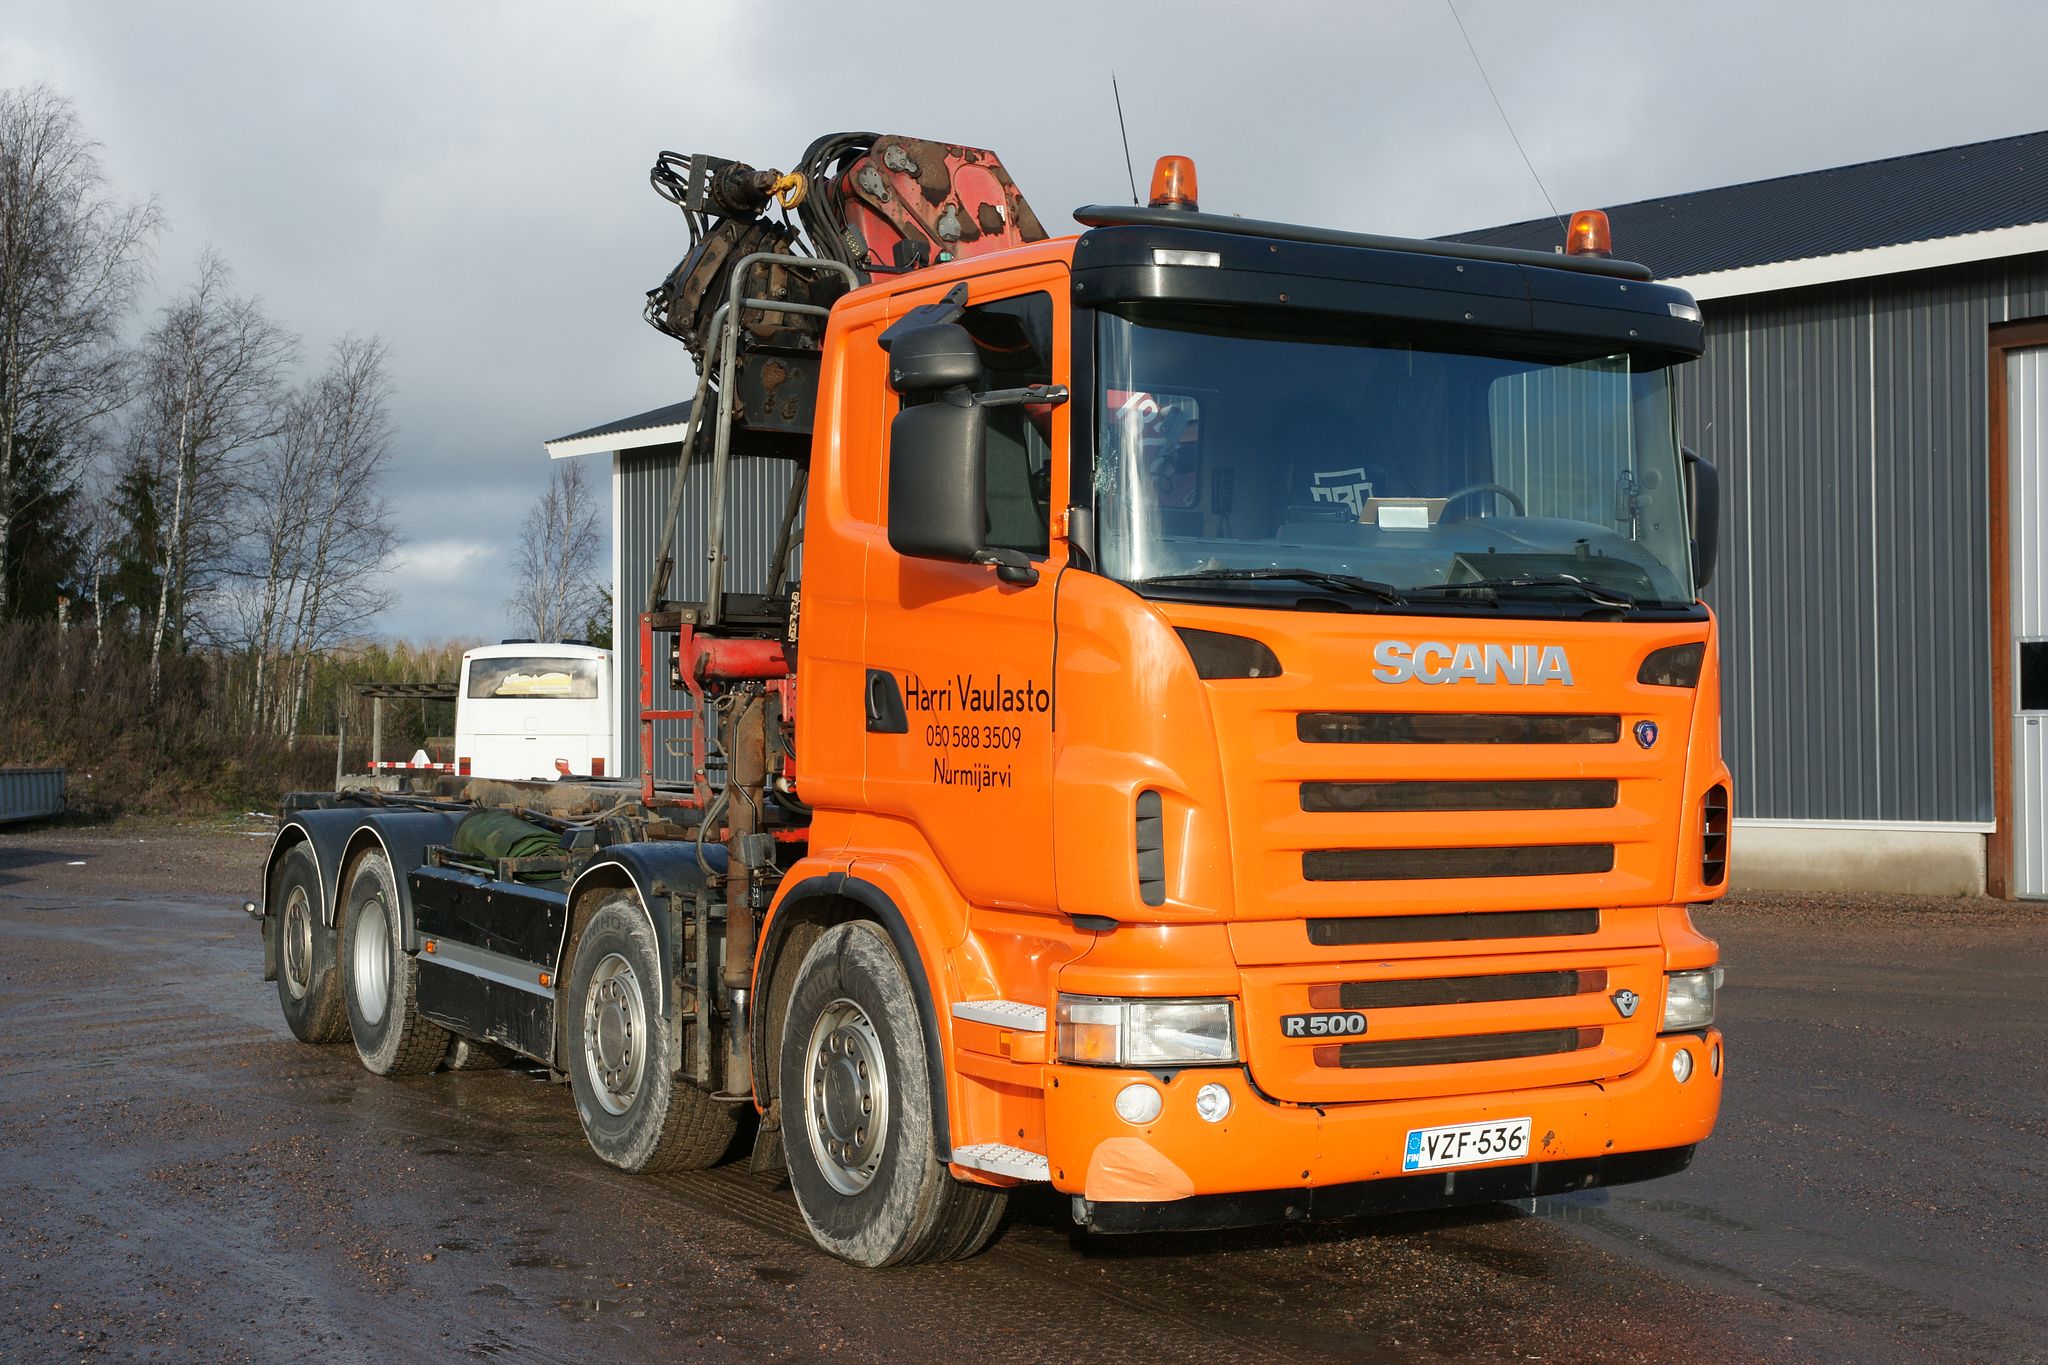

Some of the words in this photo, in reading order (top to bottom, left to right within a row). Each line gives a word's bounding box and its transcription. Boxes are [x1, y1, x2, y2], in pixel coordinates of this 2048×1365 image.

[1372, 640, 1574, 686] SCANIA
[905, 675, 952, 712] Harri
[957, 674, 1050, 713] Vaulasto
[926, 725, 950, 747] 050
[952, 726, 980, 748] 588
[983, 726, 1022, 749] 3509
[933, 757, 1012, 792] Nurmijärvi
[1310, 1015, 1365, 1035] 500
[1406, 1153, 1420, 1163] FIN
